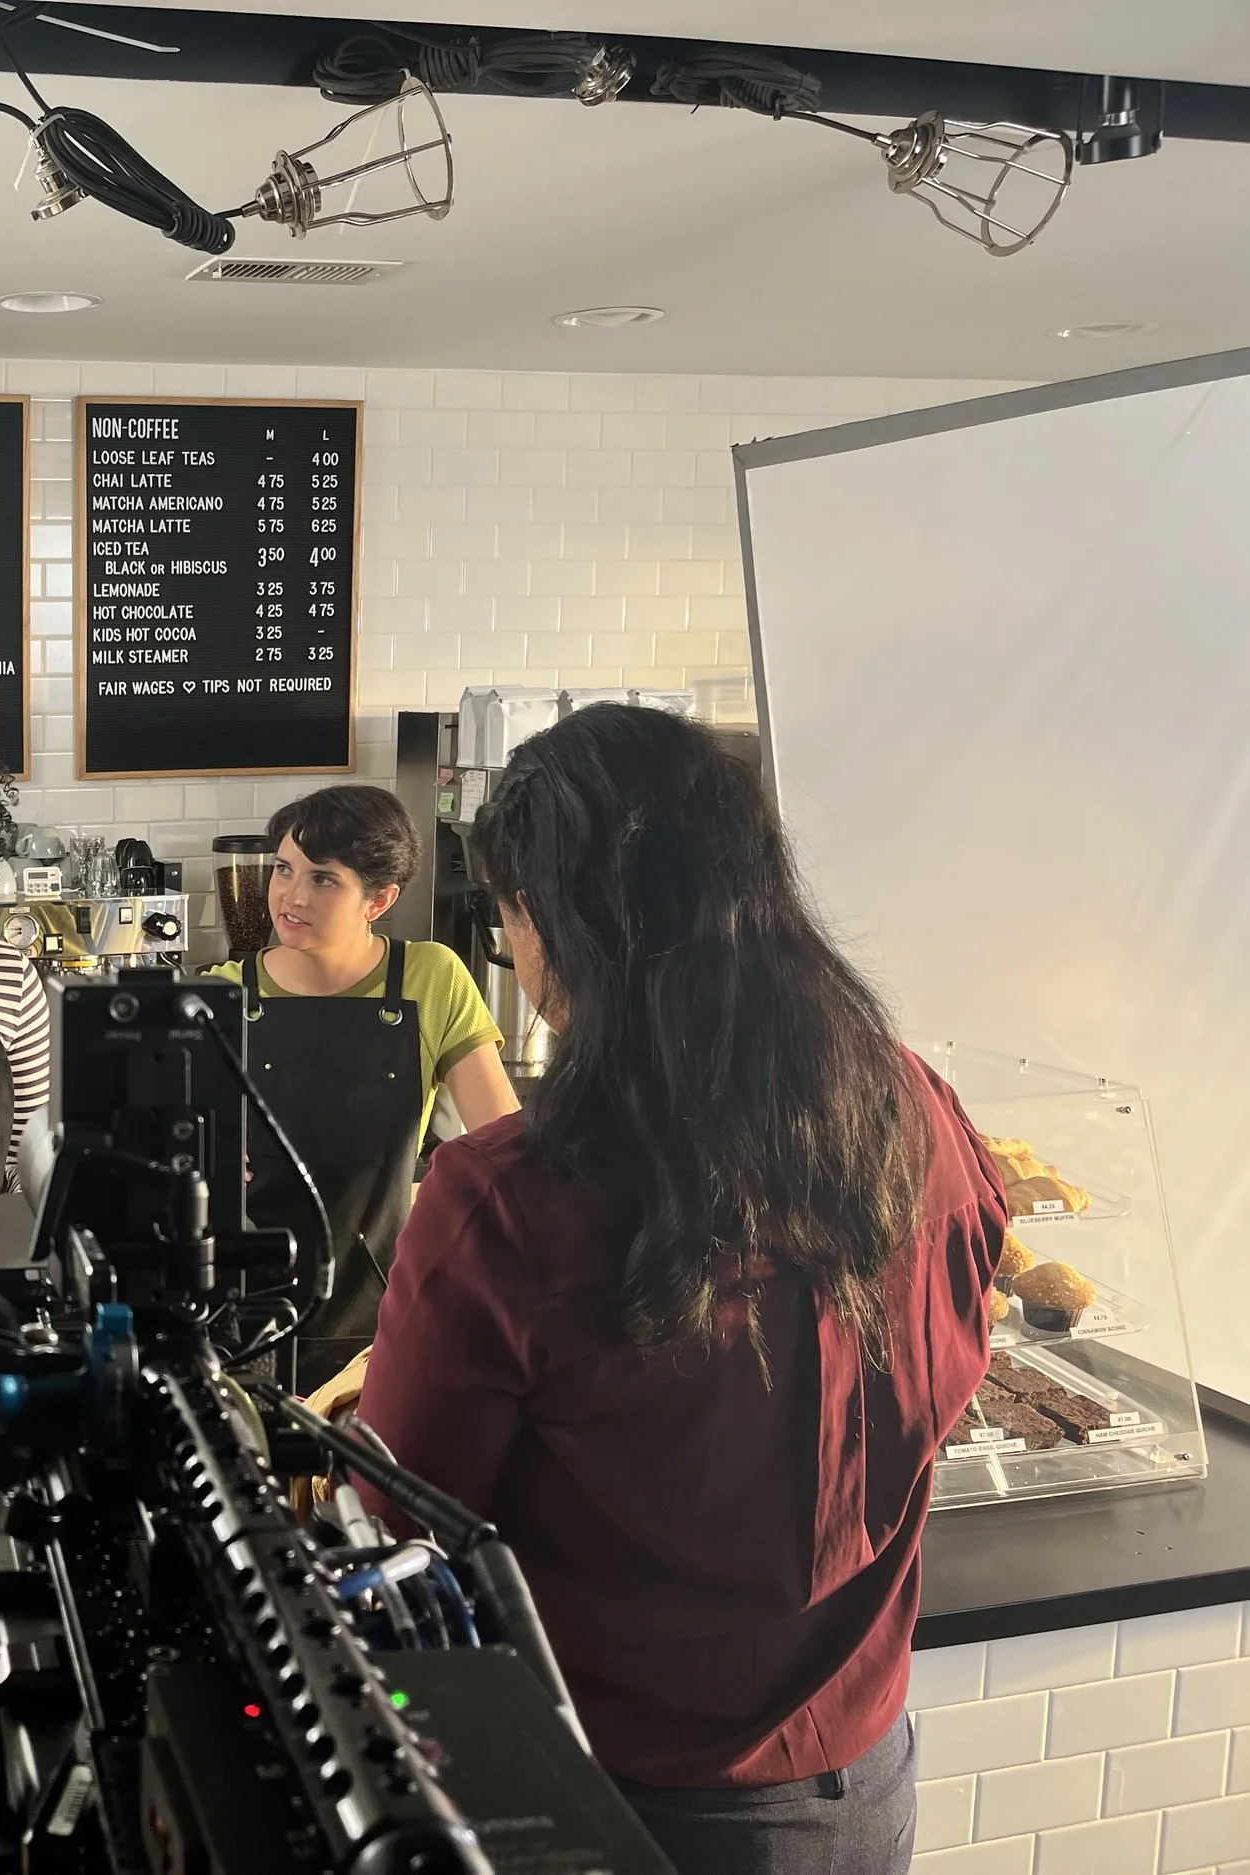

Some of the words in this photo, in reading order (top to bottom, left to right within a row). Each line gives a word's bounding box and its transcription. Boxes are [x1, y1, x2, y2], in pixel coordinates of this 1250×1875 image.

[93, 418, 178, 439] NON-COFFEE
[267, 430, 274, 440] M
[323, 430, 329, 440] L
[94, 450, 135, 464] LOOSE
[142, 451, 174, 465] LEAF
[182, 452, 214, 465] TEAS
[93, 474, 123, 487] CHAI
[131, 474, 172, 487] LATTE
[93, 496, 144, 510] MATCHA
[149, 497, 223, 510] AMERICANO
[93, 519, 144, 533] MATCHA
[151, 519, 190, 533] LATTE
[93, 542, 121, 555] ICED
[125, 542, 149, 555] TEA
[106, 561, 145, 575] BLACK
[171, 561, 227, 574] HIBISCUS
[94, 583, 160, 597] LEMONADE
[94, 606, 116, 619] HOT
[122, 605, 193, 619] CHOCOLATE
[94, 628, 121, 642] KIDS
[127, 628, 150, 641] HOT
[155, 627, 196, 641] COCOA
[93, 650, 124, 664] MILK
[129, 649, 188, 663] STEAMER
[99, 682, 126, 695] FAIR
[132, 681, 174, 694] WAGES
[202, 680, 229, 693] TIPS
[238, 679, 262, 692] NOT
[270, 678, 331, 691] REQUIRED
